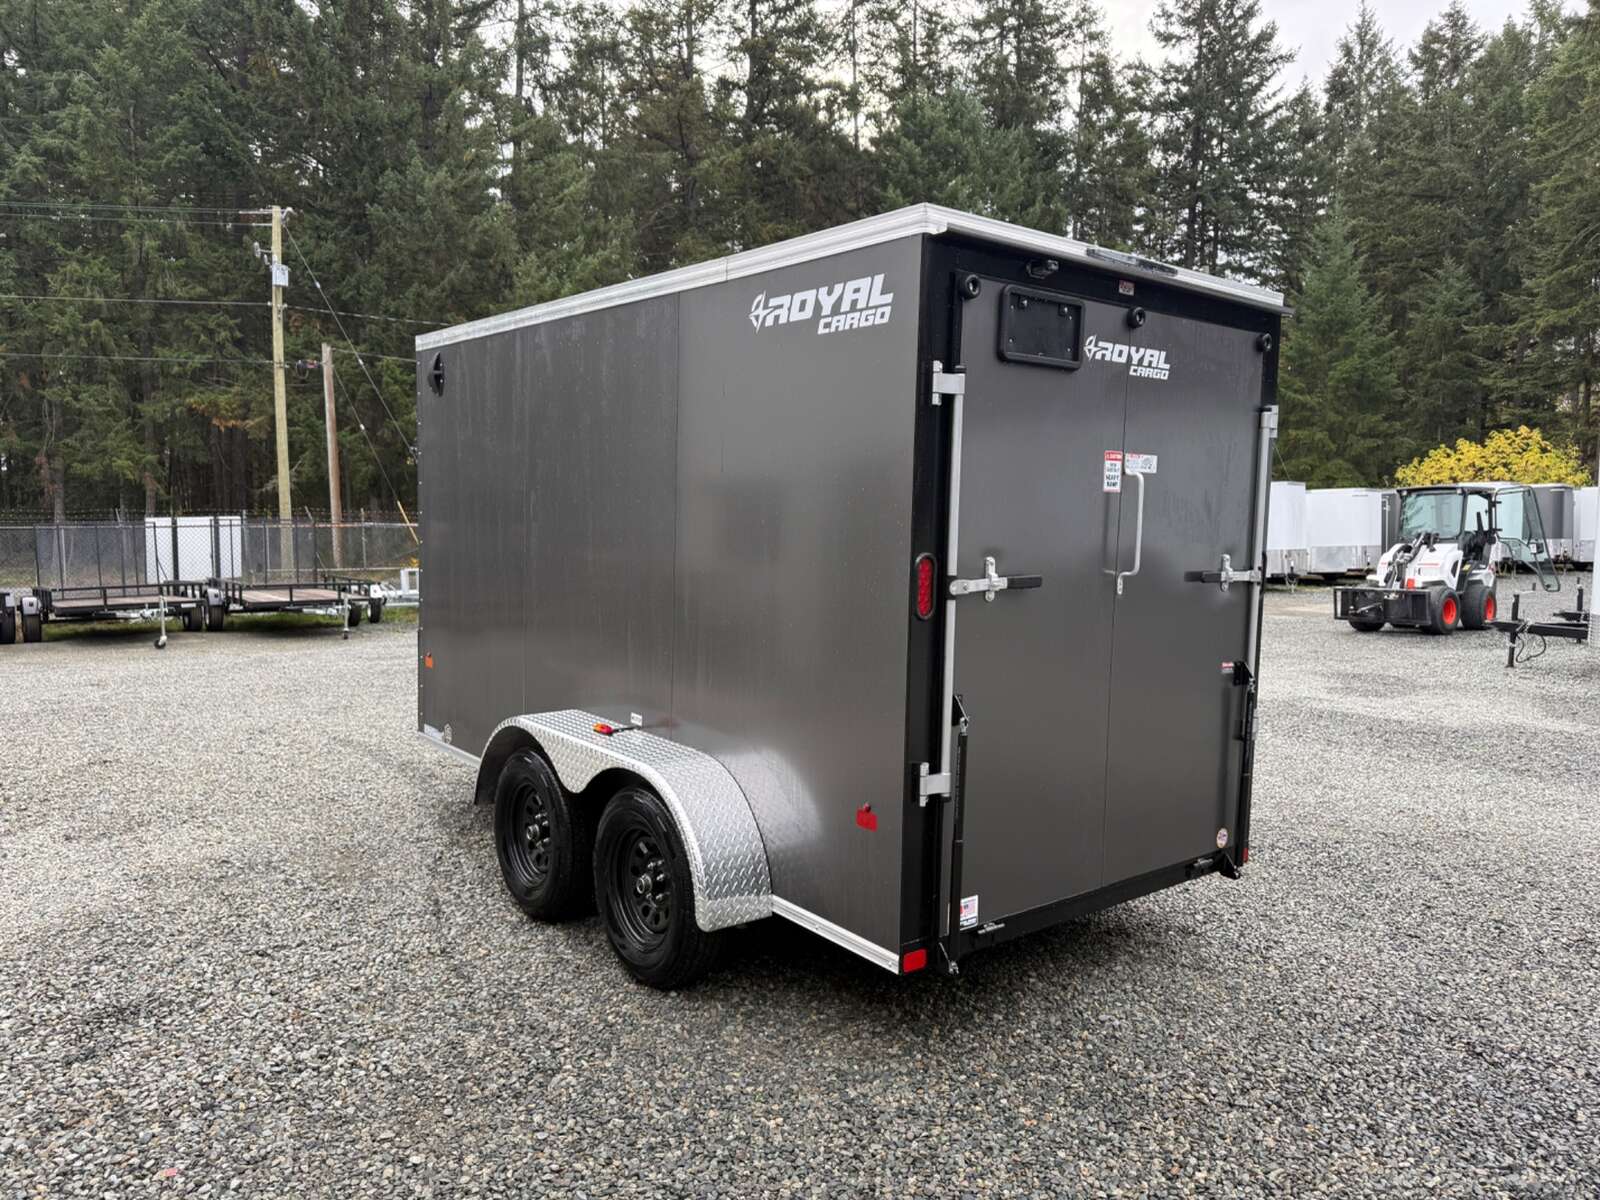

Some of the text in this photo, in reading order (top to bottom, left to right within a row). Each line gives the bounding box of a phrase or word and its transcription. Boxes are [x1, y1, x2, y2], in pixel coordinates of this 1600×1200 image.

[764, 273, 894, 328] ROYAL
[817, 305, 892, 335] CARGO
[1094, 340, 1171, 370] ROYAL
[1129, 365, 1169, 380] CARGO
